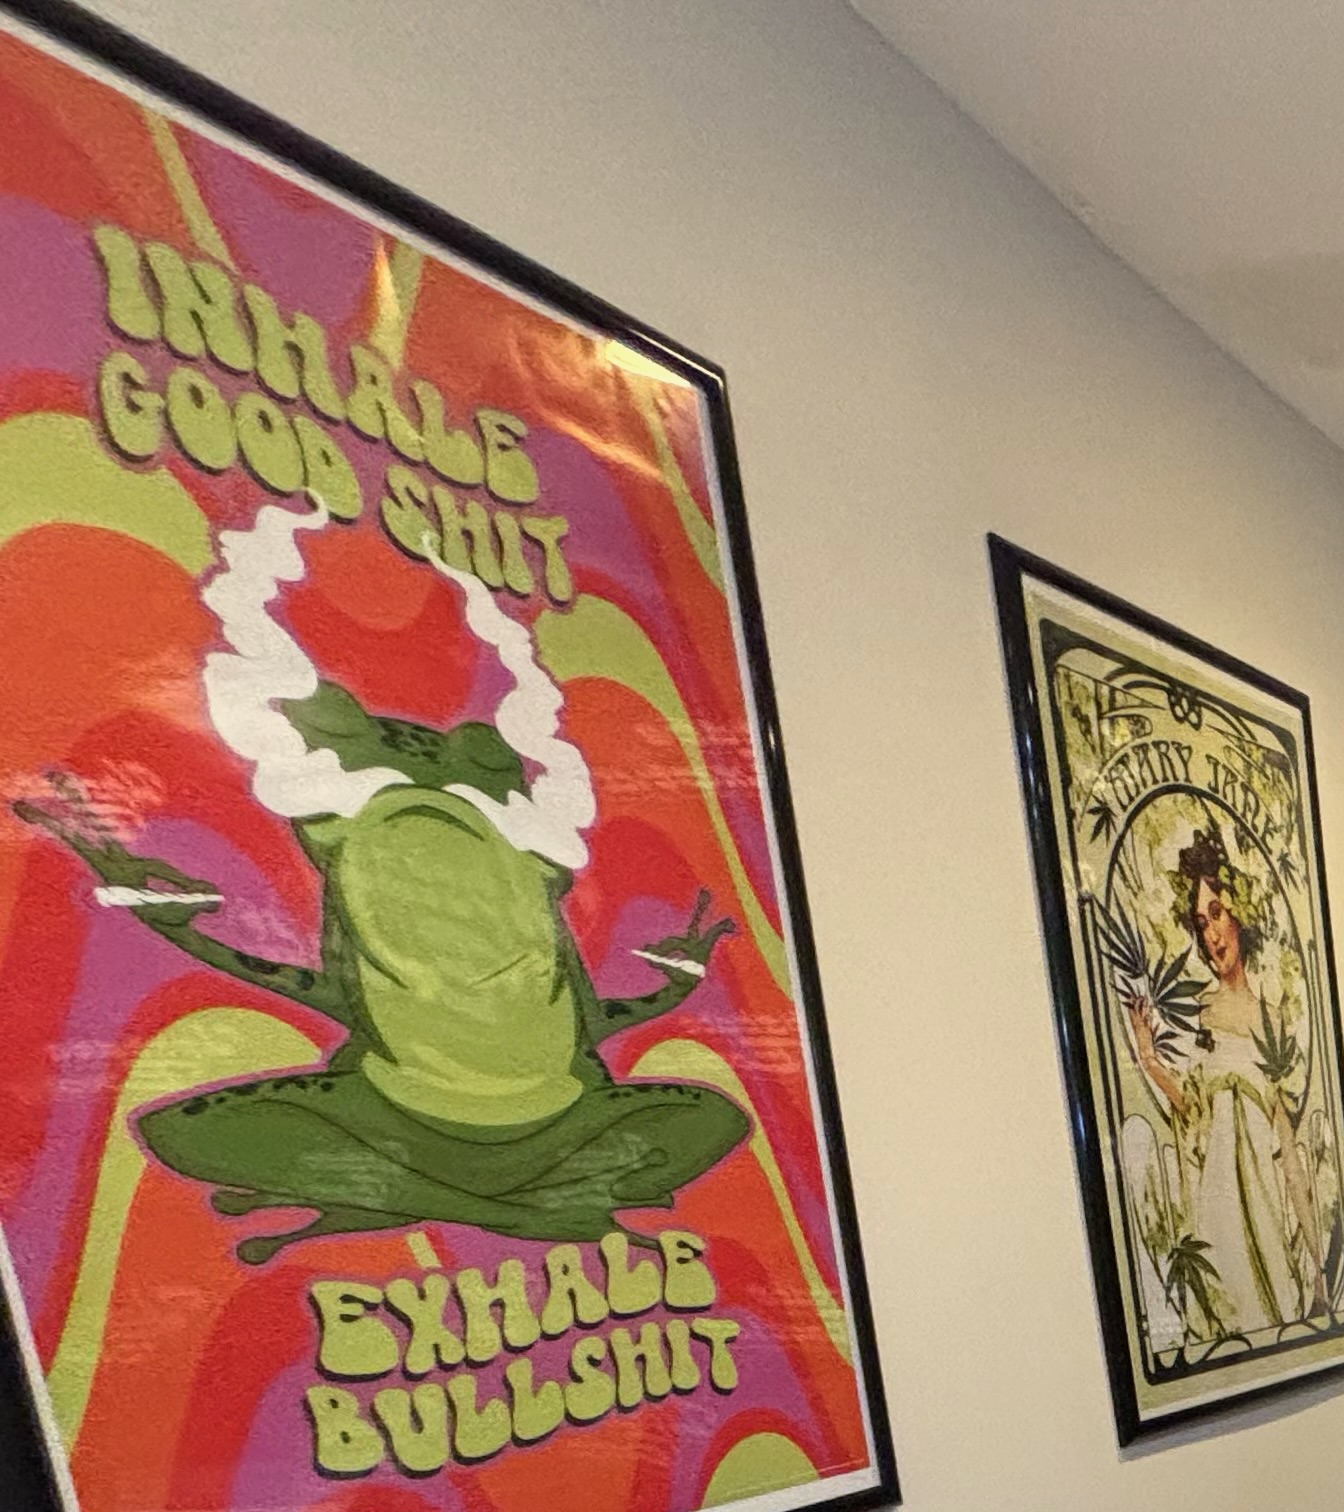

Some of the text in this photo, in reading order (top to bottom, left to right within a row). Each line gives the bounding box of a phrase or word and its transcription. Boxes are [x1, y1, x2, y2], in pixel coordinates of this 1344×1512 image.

[94, 223, 541, 507] INHALE
[98, 351, 572, 606] GOOD SHIT
[304, 1317, 741, 1478] BULLSHIT
[309, 1230, 718, 1381] EXHALE
